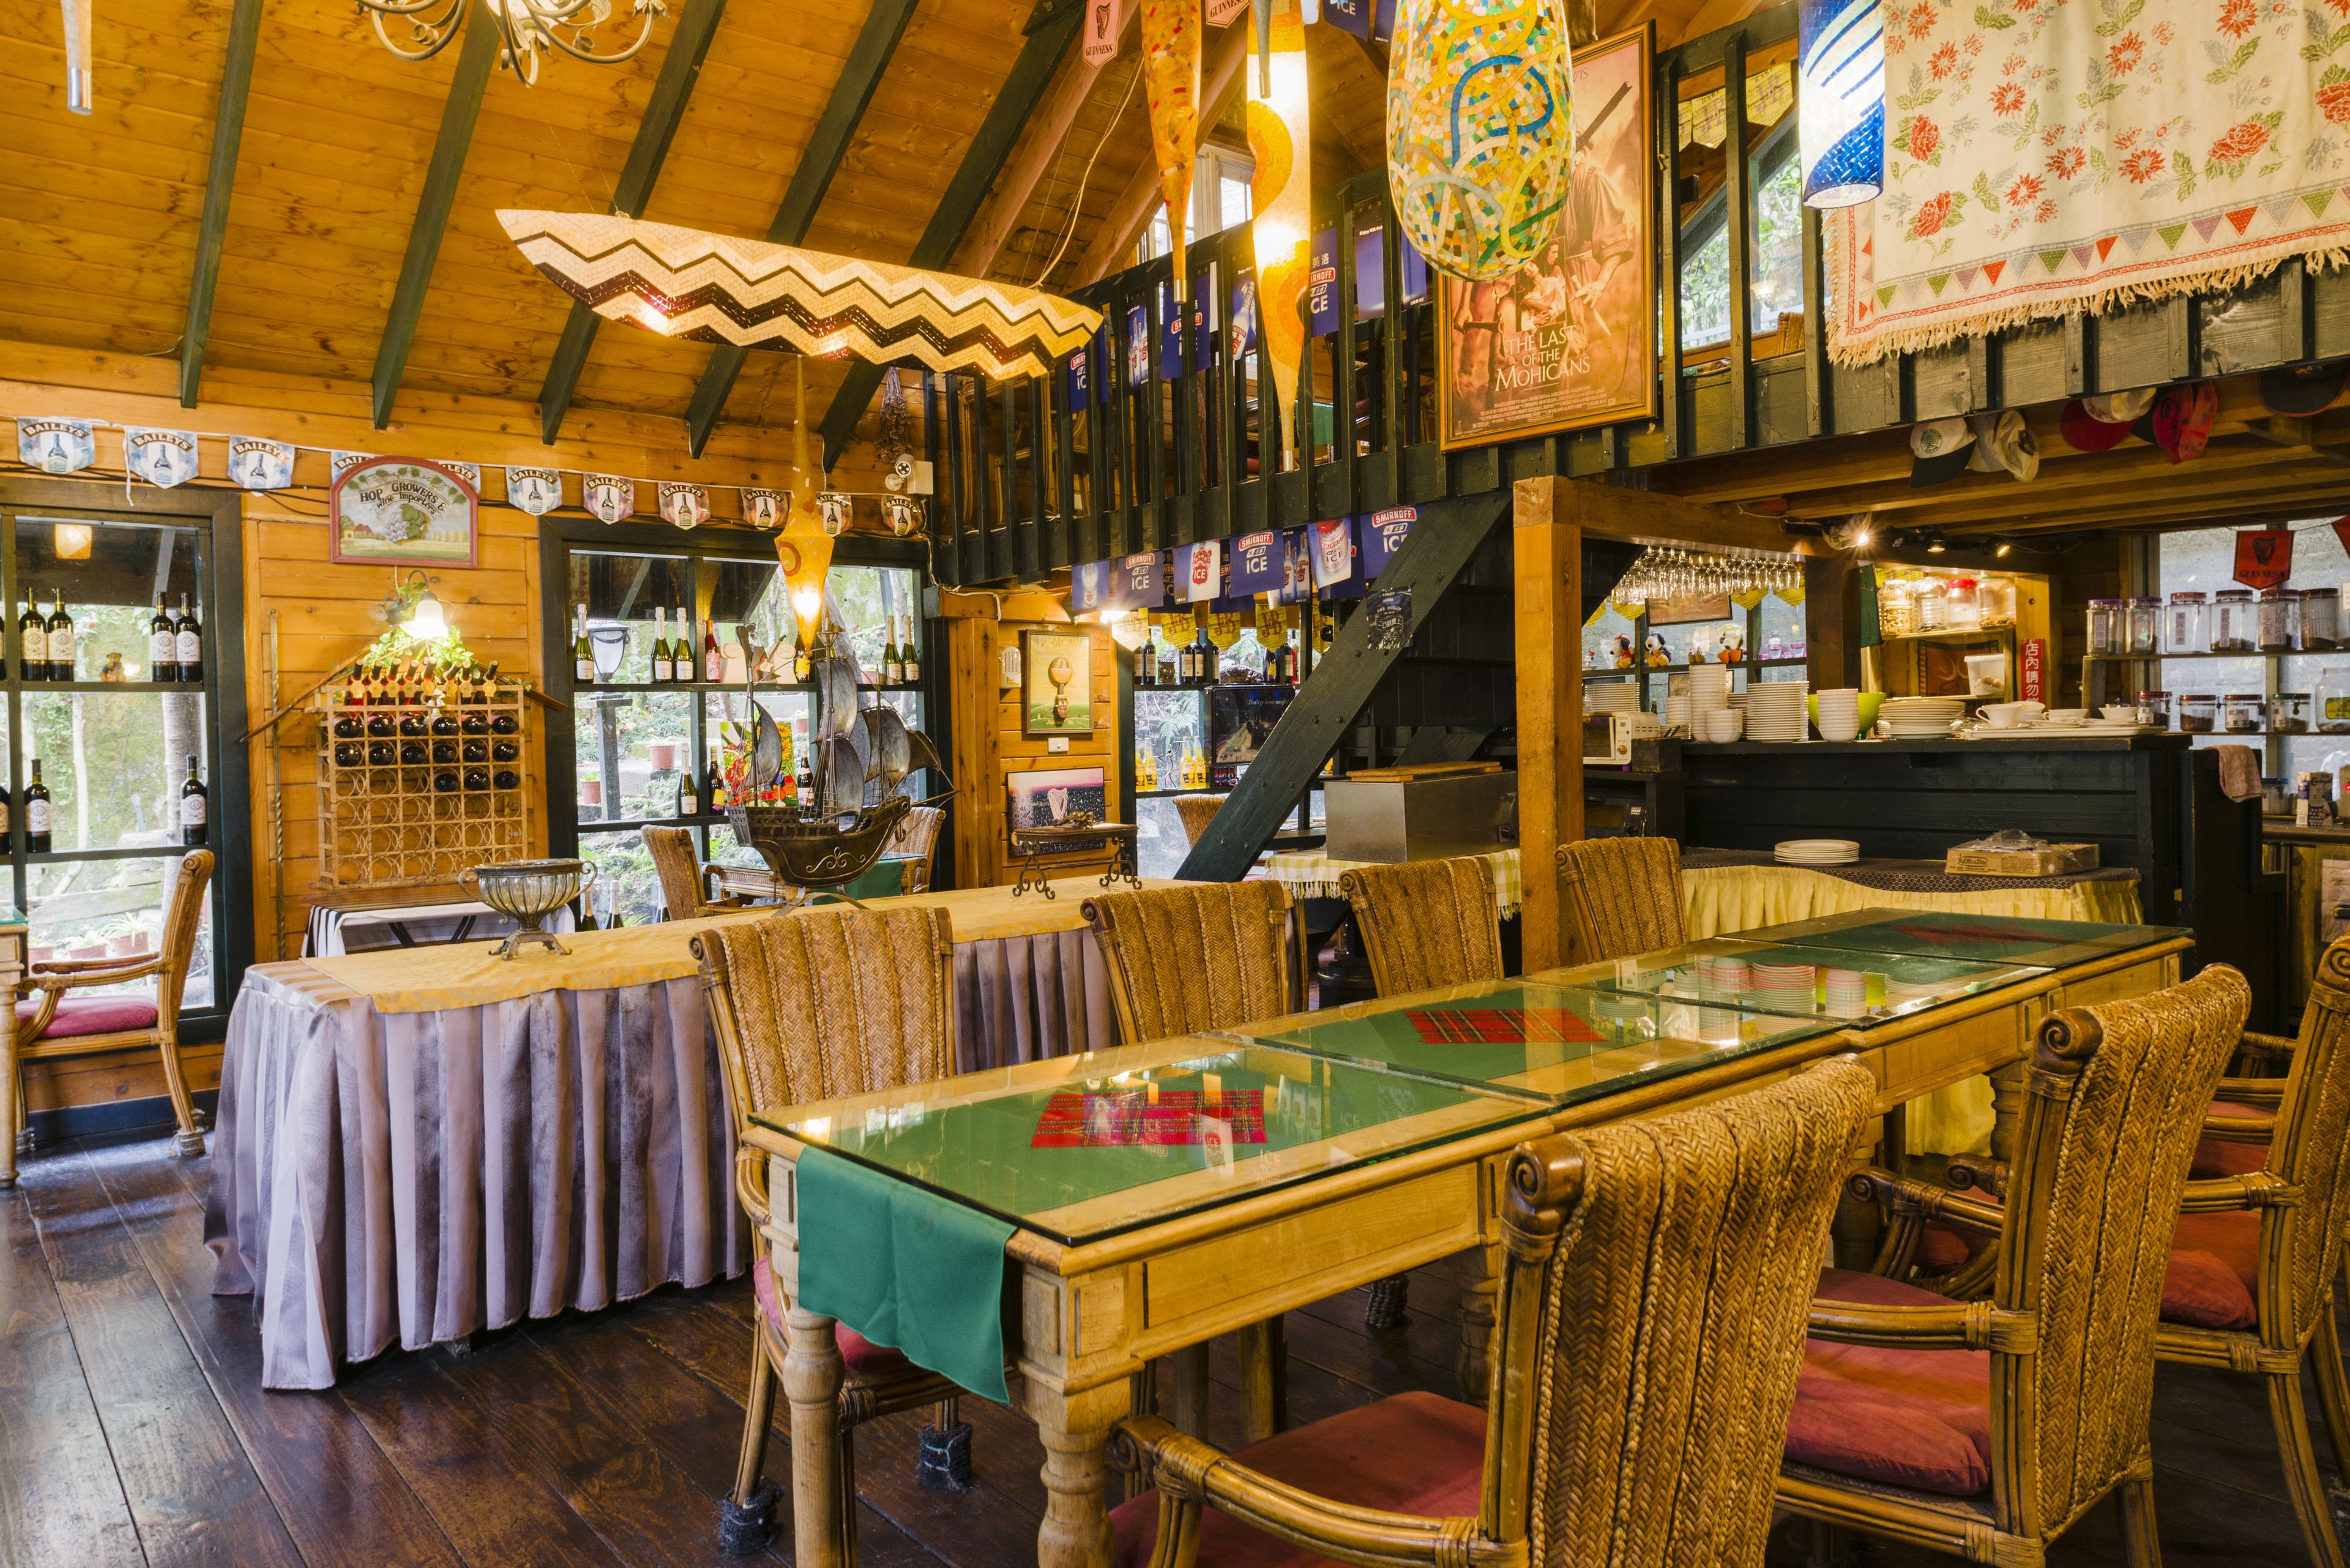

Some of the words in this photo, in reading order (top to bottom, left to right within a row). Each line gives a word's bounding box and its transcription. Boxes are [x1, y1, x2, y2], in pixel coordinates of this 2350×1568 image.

[1312, 253, 1329, 268] 美洛
[1311, 270, 1332, 283] IRNOFF
[1310, 294, 1328, 314] CE
[1507, 335, 1537, 355] THE
[1540, 324, 1577, 348] LAST
[1523, 353, 1538, 367] OF
[1539, 349, 1560, 364] THE
[1495, 357, 1591, 392] MOHICANS
[1077, 375, 1086, 390] IC
[360, 488, 384, 502] HOP
[392, 482, 439, 504] GROWERS
[438, 502, 446, 512] &
[1376, 509, 1412, 524] SMIRNOFF
[1241, 534, 1270, 547] SMIRNOFF
[1128, 554, 1152, 566] SMIRNOFF
[1246, 556, 1268, 574] ICE
[1194, 569, 1206, 579] ICE
[1132, 575, 1149, 590] ICE
